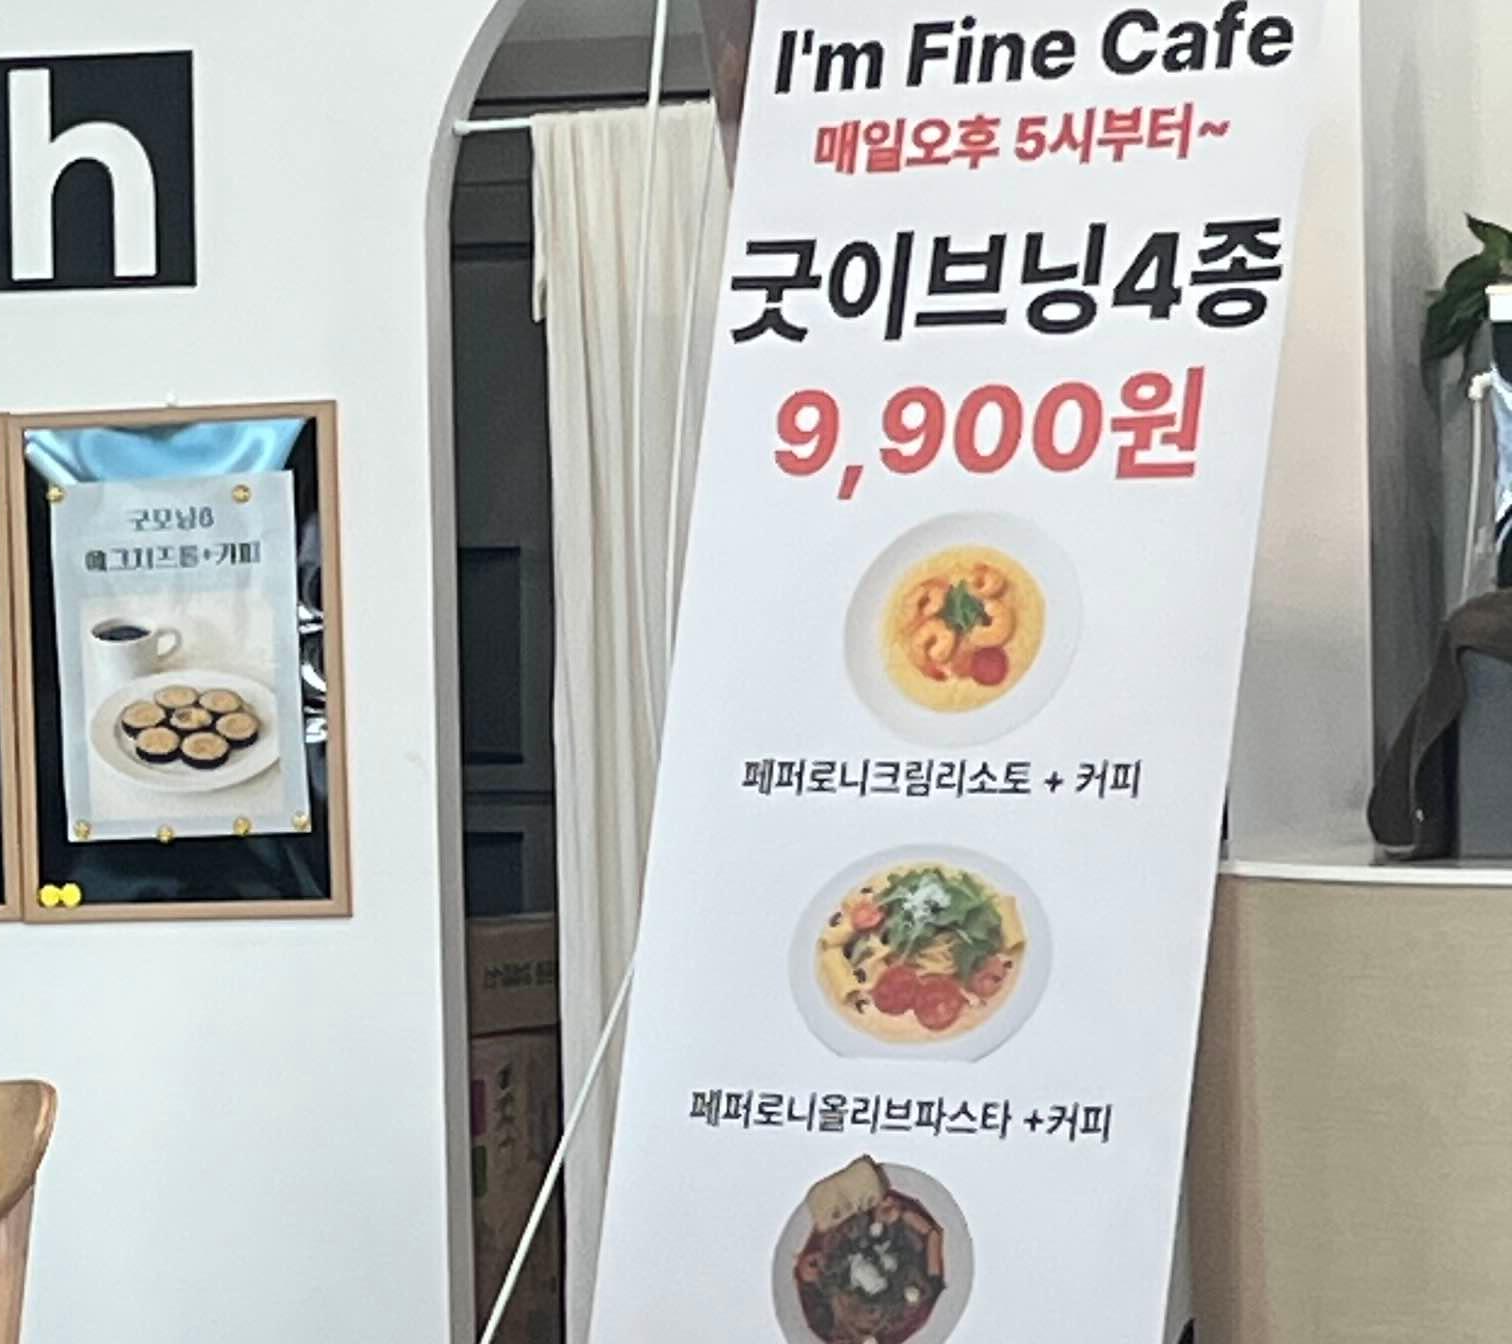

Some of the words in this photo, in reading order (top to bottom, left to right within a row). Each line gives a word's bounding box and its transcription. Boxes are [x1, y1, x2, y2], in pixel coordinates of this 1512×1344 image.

[774, 29, 884, 95] I'm
[904, 15, 1077, 88] Fine
[1100, 0, 1295, 76] Cafe
[814, 115, 1001, 175] 매일오후
[1015, 102, 1230, 166] 5시부터~
[730, 217, 1284, 344] 굿이브닝4종
[773, 366, 1206, 500] 9,900원
[741, 758, 1031, 798] 페퍼로니크림리소토
[1076, 758, 1142, 799] 커피
[689, 1088, 1013, 1140] 페퍼로니올리브파스타
